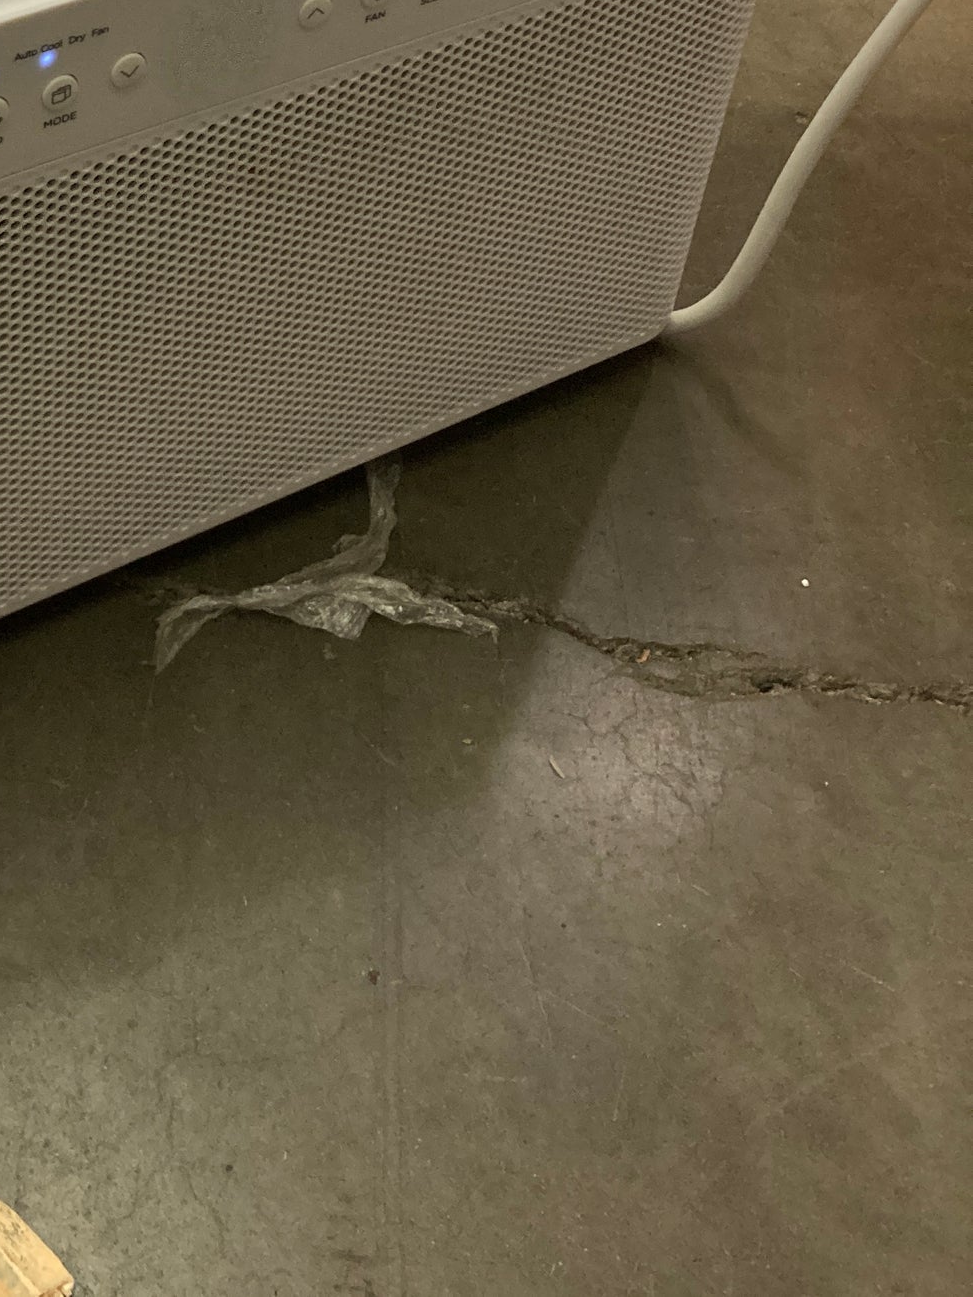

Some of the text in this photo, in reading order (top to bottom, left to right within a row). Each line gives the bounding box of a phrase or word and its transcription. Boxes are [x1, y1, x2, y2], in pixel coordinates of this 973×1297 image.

[364, 10, 387, 23] FAN
[15, 25, 110, 62] Auto Cool Dry Fan
[43, 110, 78, 129] MODE
